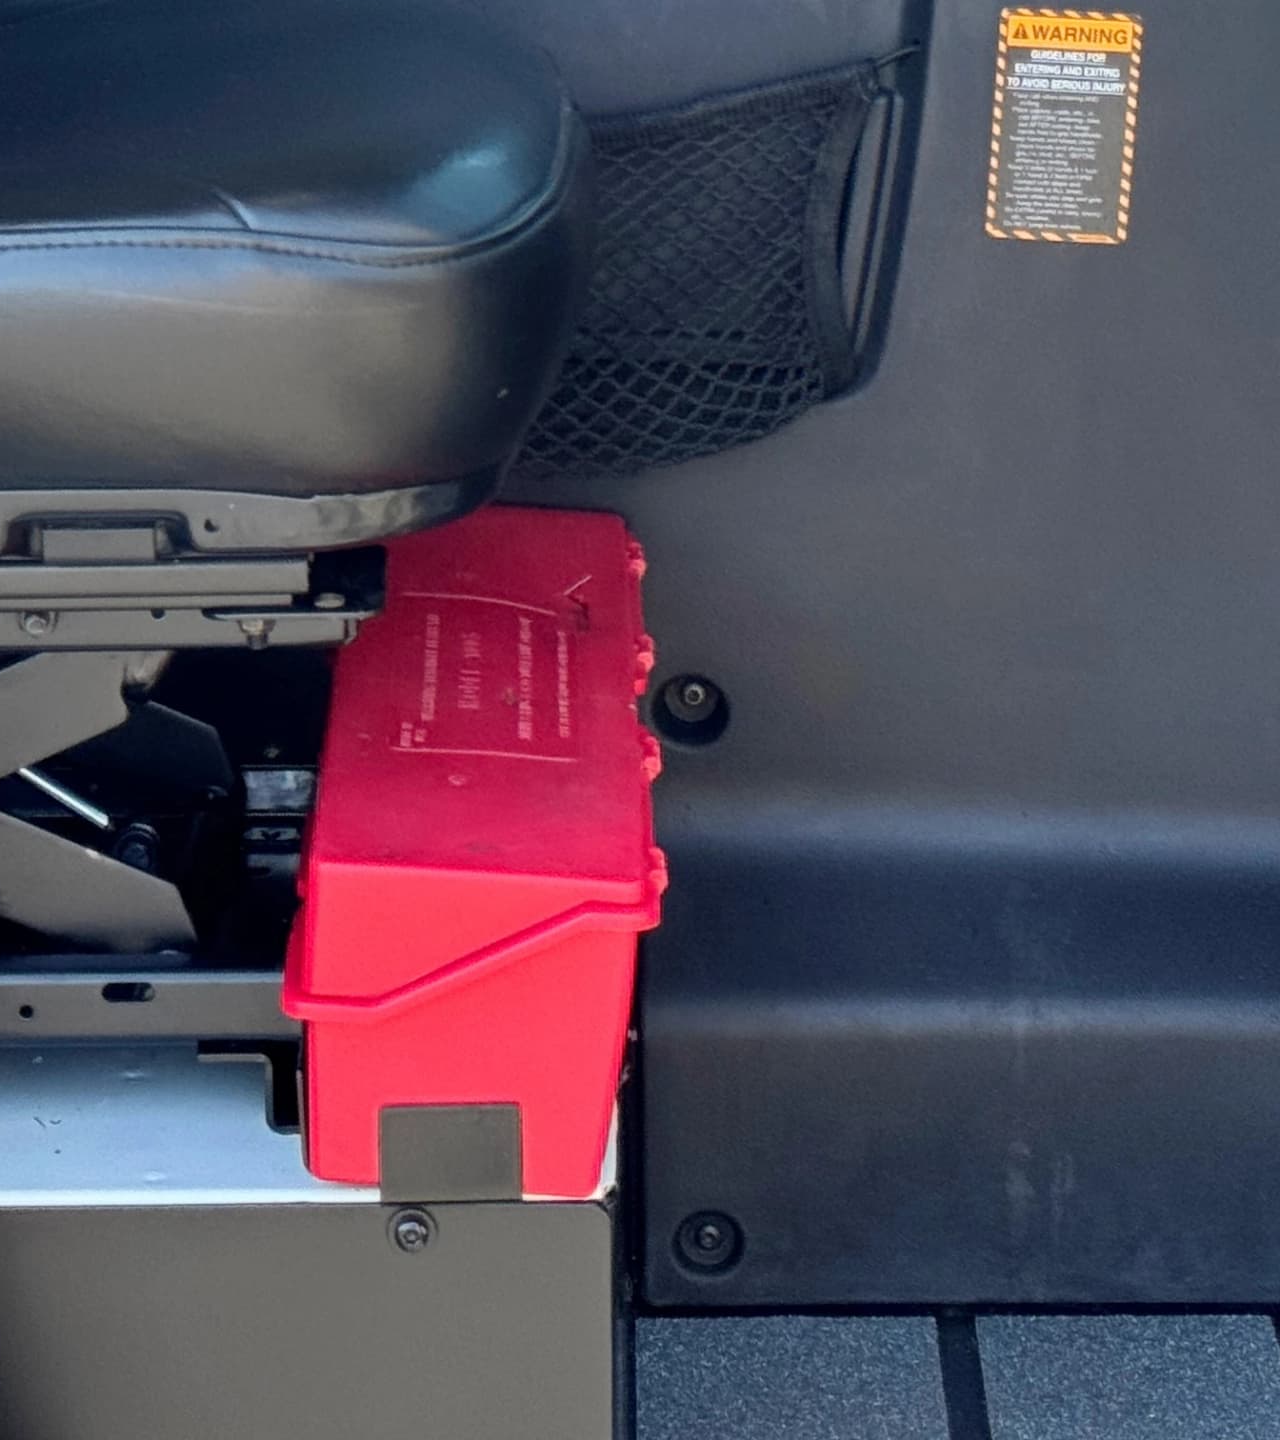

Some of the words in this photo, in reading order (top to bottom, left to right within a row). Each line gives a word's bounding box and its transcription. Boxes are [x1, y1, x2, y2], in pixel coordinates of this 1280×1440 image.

[1031, 24, 1128, 45] WARNING
[1031, 50, 1086, 62] GUIDELINES
[1087, 52, 1106, 63] FOR
[1015, 63, 1061, 75] ENTERING
[1063, 65, 1083, 76] AND
[1084, 67, 1120, 78] EXITING
[1007, 77, 1020, 87] TO
[1021, 77, 1050, 89] AVOID
[1050, 79, 1091, 91] SERIOUS
[1092, 81, 1126, 93] INJURY
